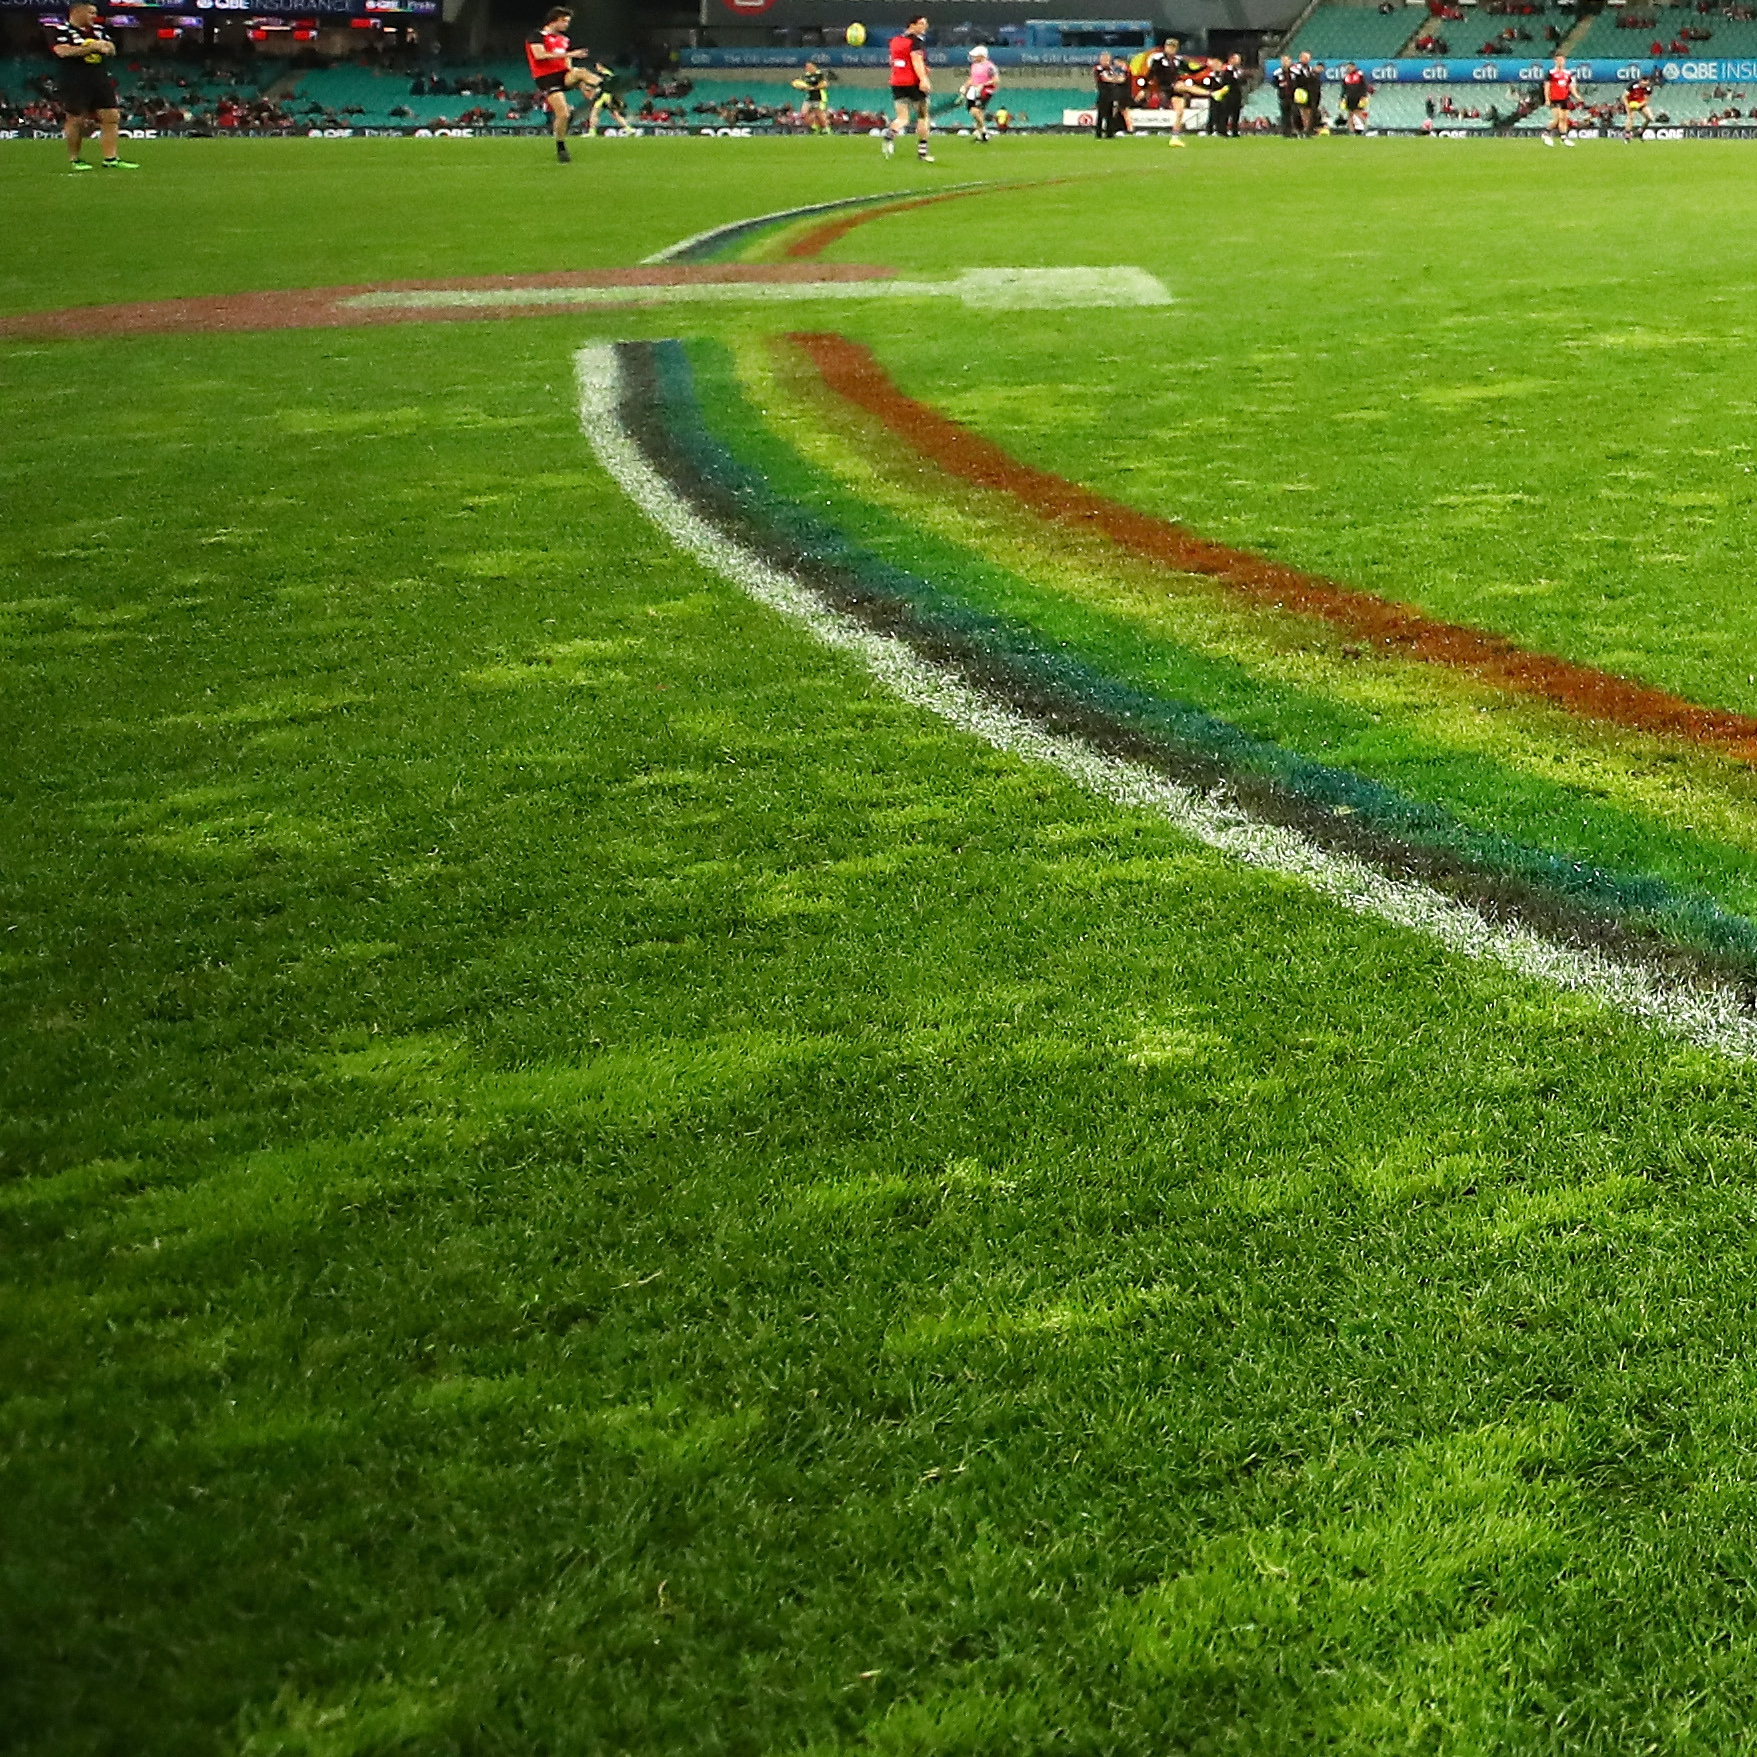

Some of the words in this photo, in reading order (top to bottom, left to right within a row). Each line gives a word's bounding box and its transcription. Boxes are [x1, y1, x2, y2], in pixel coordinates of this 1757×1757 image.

[1325, 64, 1348, 79] cit
[1371, 63, 1397, 80] citi
[1422, 63, 1448, 80] citi
[1472, 63, 1498, 80] citi
[1519, 63, 1544, 80] citi
[1617, 63, 1641, 80] citi
[1681, 63, 1717, 79] QBE
[1656, 129, 1684, 139] QBE
